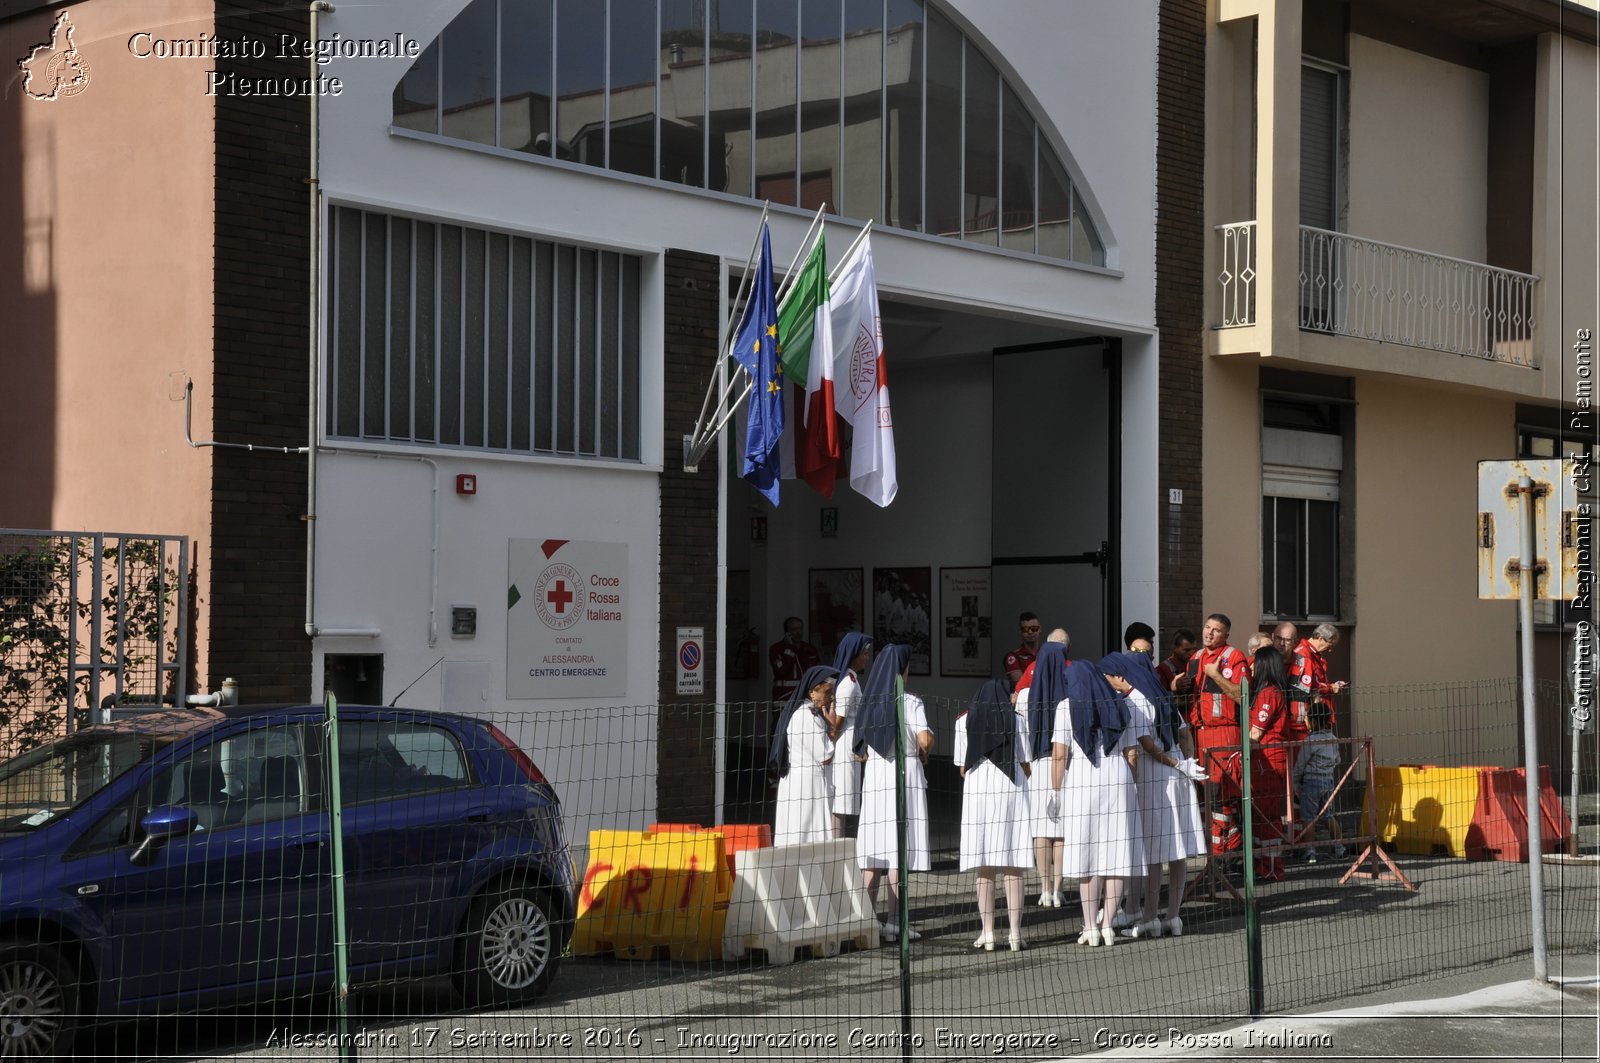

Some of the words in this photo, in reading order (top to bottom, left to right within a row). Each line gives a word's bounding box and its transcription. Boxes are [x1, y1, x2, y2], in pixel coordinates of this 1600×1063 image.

[590, 574, 620, 587] Croce
[589, 592, 620, 604] Rossa
[587, 609, 622, 621] Italiana
[543, 655, 595, 664] ALESSANDRIA
[529, 668, 560, 677] CENTRO
[562, 668, 607, 676] EMERGENZE
[679, 679, 701, 687] carrabile
